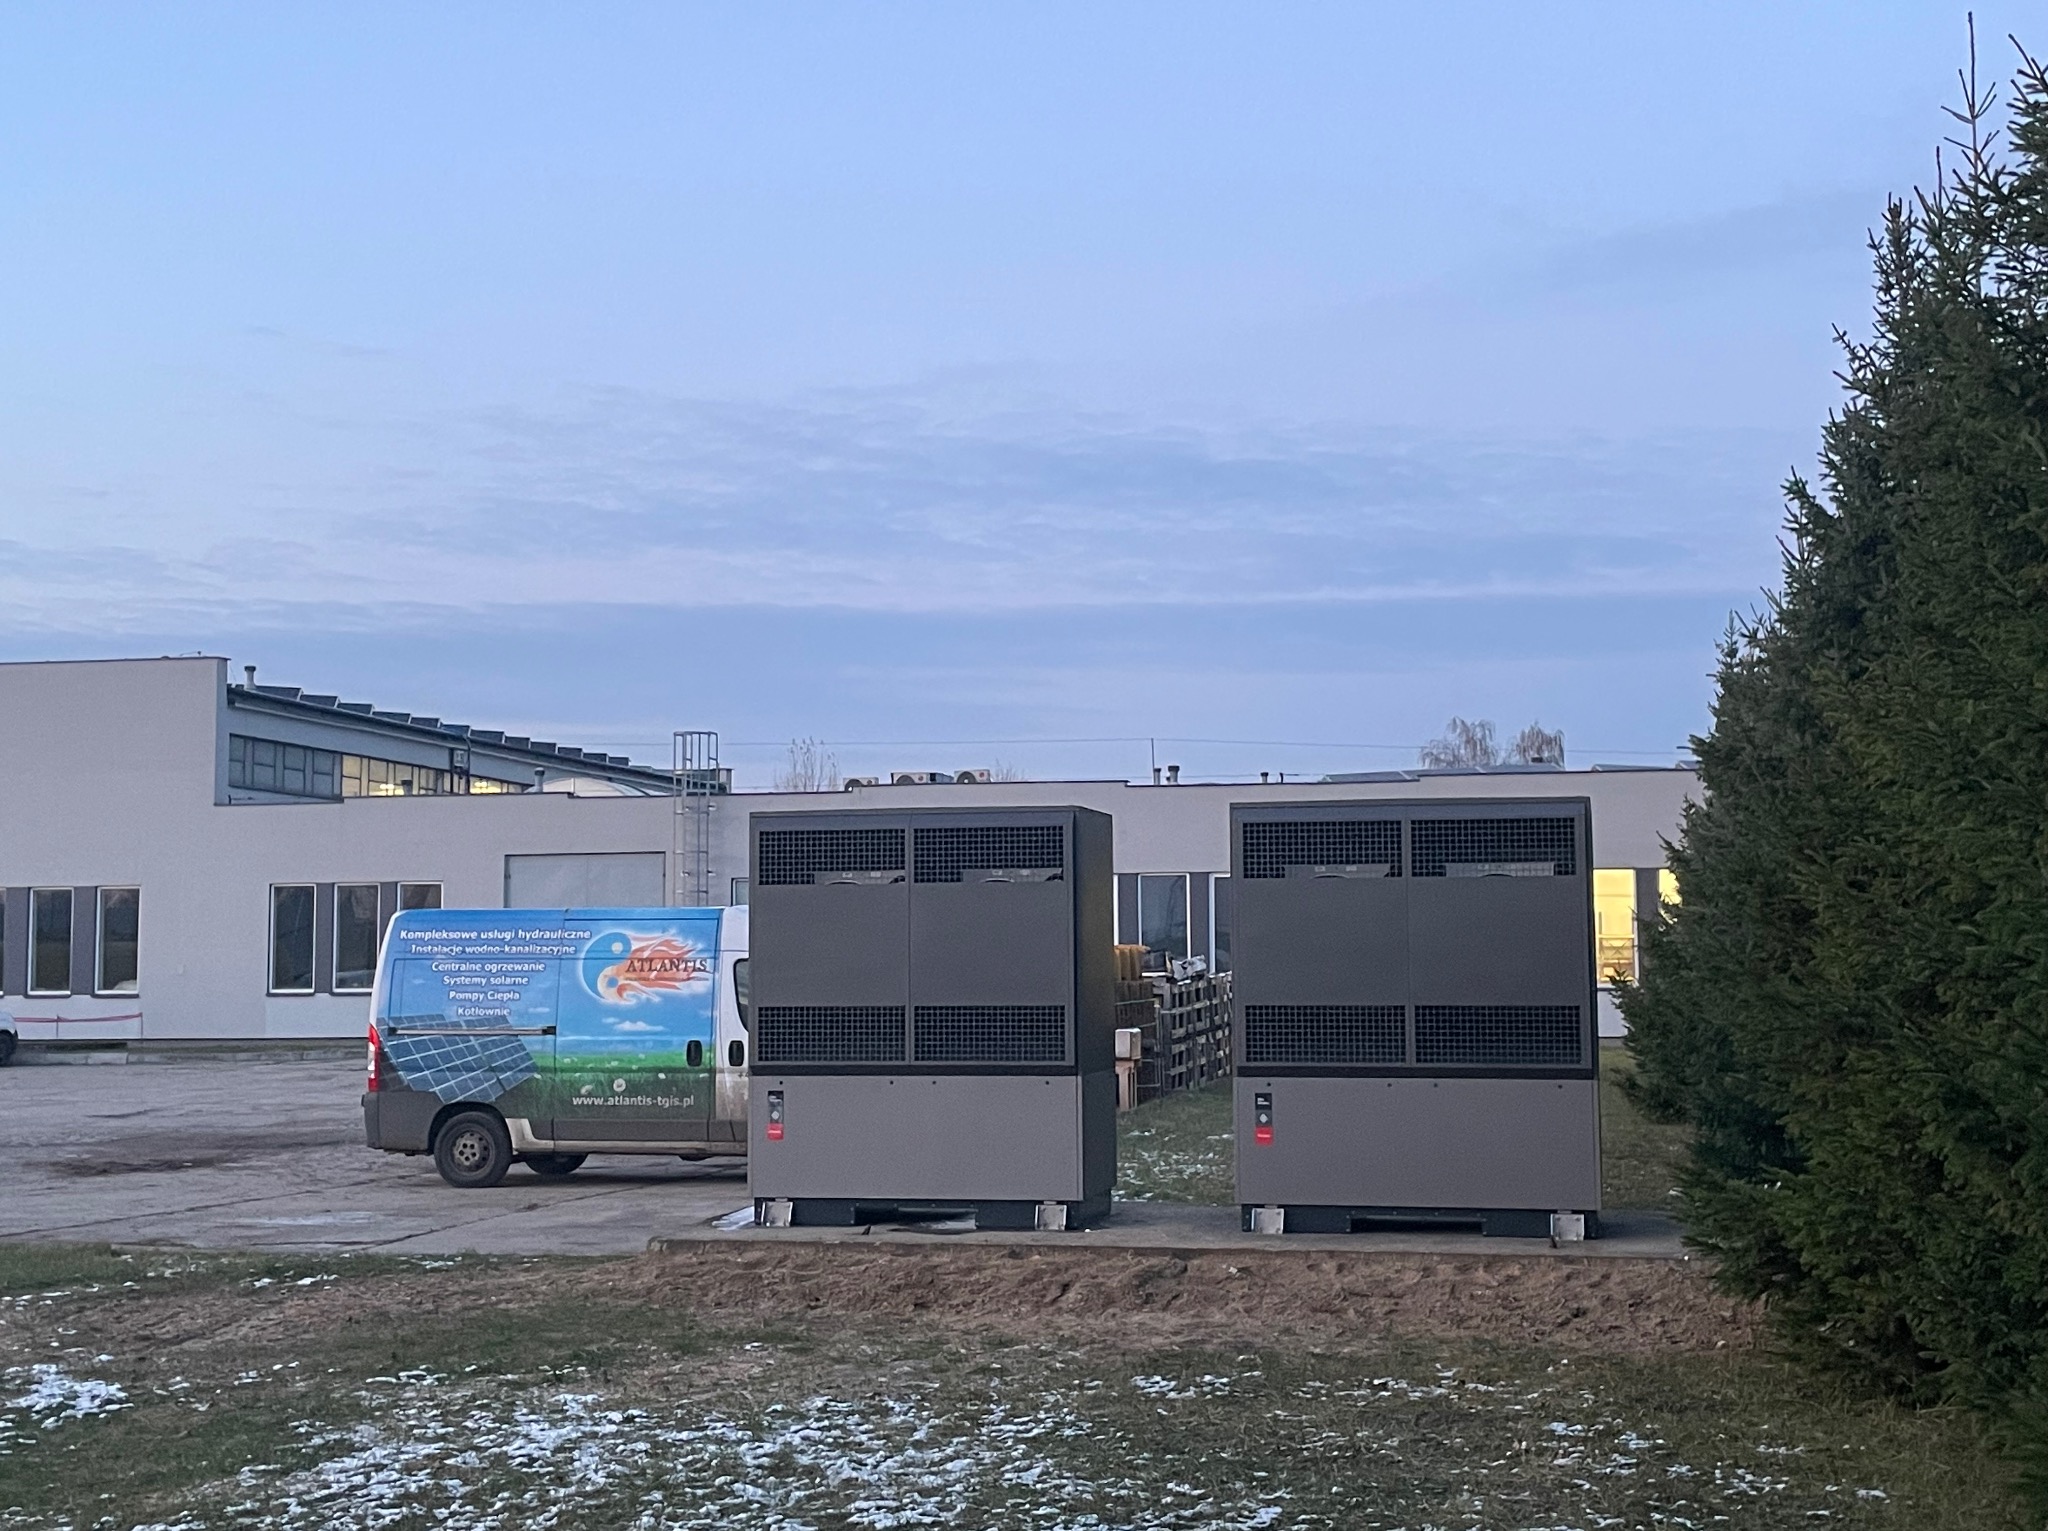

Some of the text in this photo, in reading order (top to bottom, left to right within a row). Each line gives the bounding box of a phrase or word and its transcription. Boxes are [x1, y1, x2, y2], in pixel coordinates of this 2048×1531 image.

[400, 929, 477, 941] Kompleksowe
[518, 929, 591, 940] hydrauliczne
[411, 944, 576, 955] Instalacje wodno-kanalizacyjne
[432, 961, 545, 973] Centralne ogrzewanie
[625, 959, 708, 972] ATLANTIS
[443, 976, 529, 986] Systemy solarne
[449, 991, 485, 1001] Pompy
[572, 1095, 694, 1108] www.atlantis-tgis.pl
